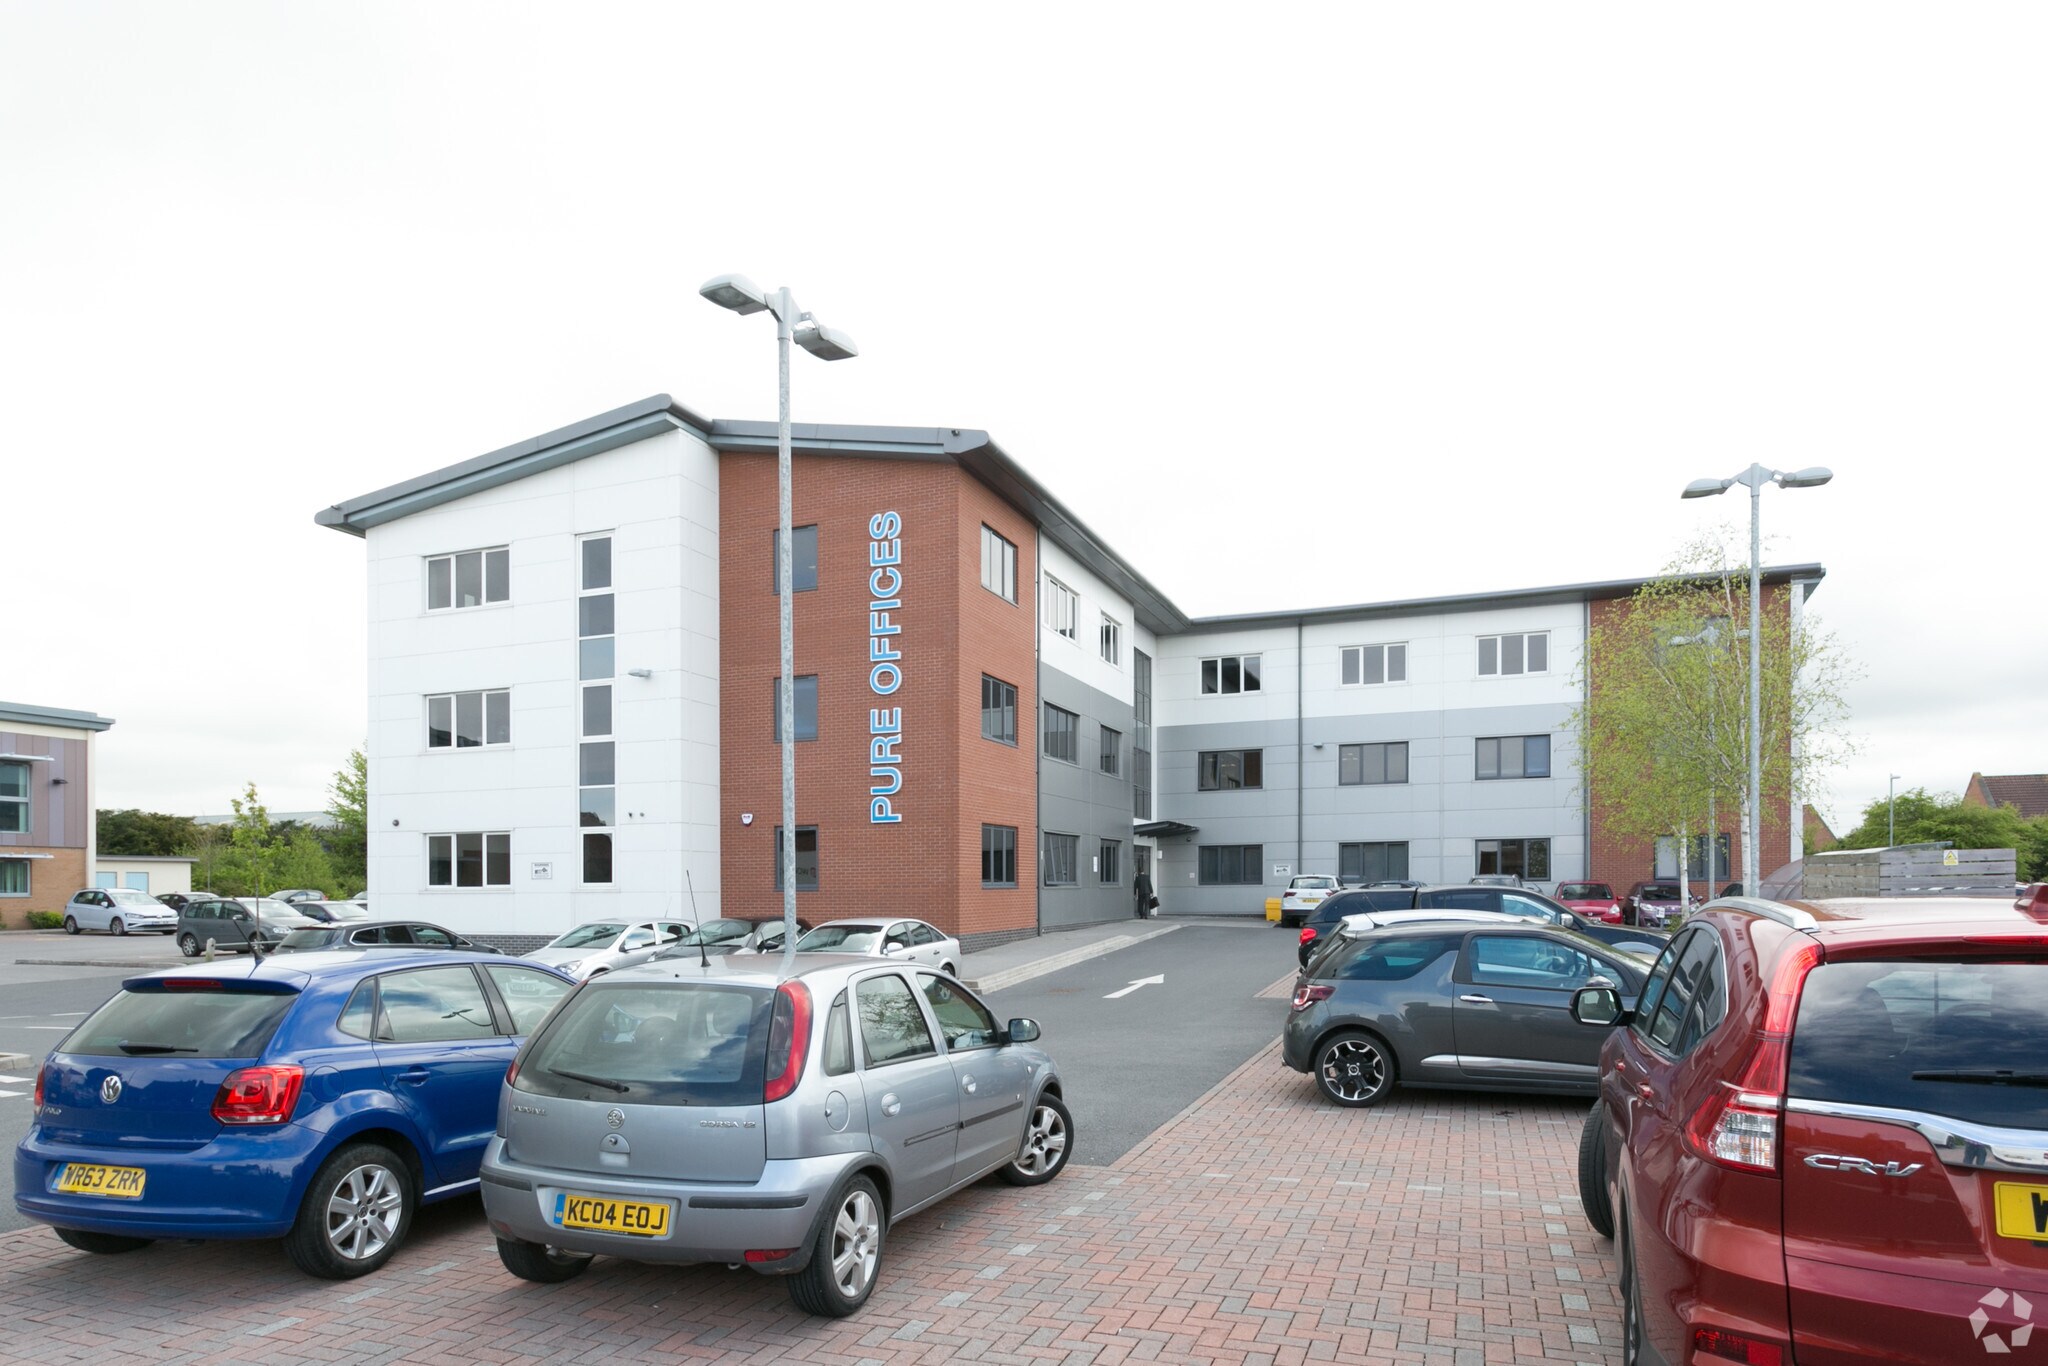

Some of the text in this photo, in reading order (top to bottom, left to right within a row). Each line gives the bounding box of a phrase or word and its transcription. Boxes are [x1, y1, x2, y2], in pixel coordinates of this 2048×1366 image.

[869, 510, 902, 824] PURE OFFICES
[1803, 1153, 1924, 1177] CR-V
[63, 1166, 145, 1191] WR63 ZRK
[567, 1199, 617, 1226] KC04
